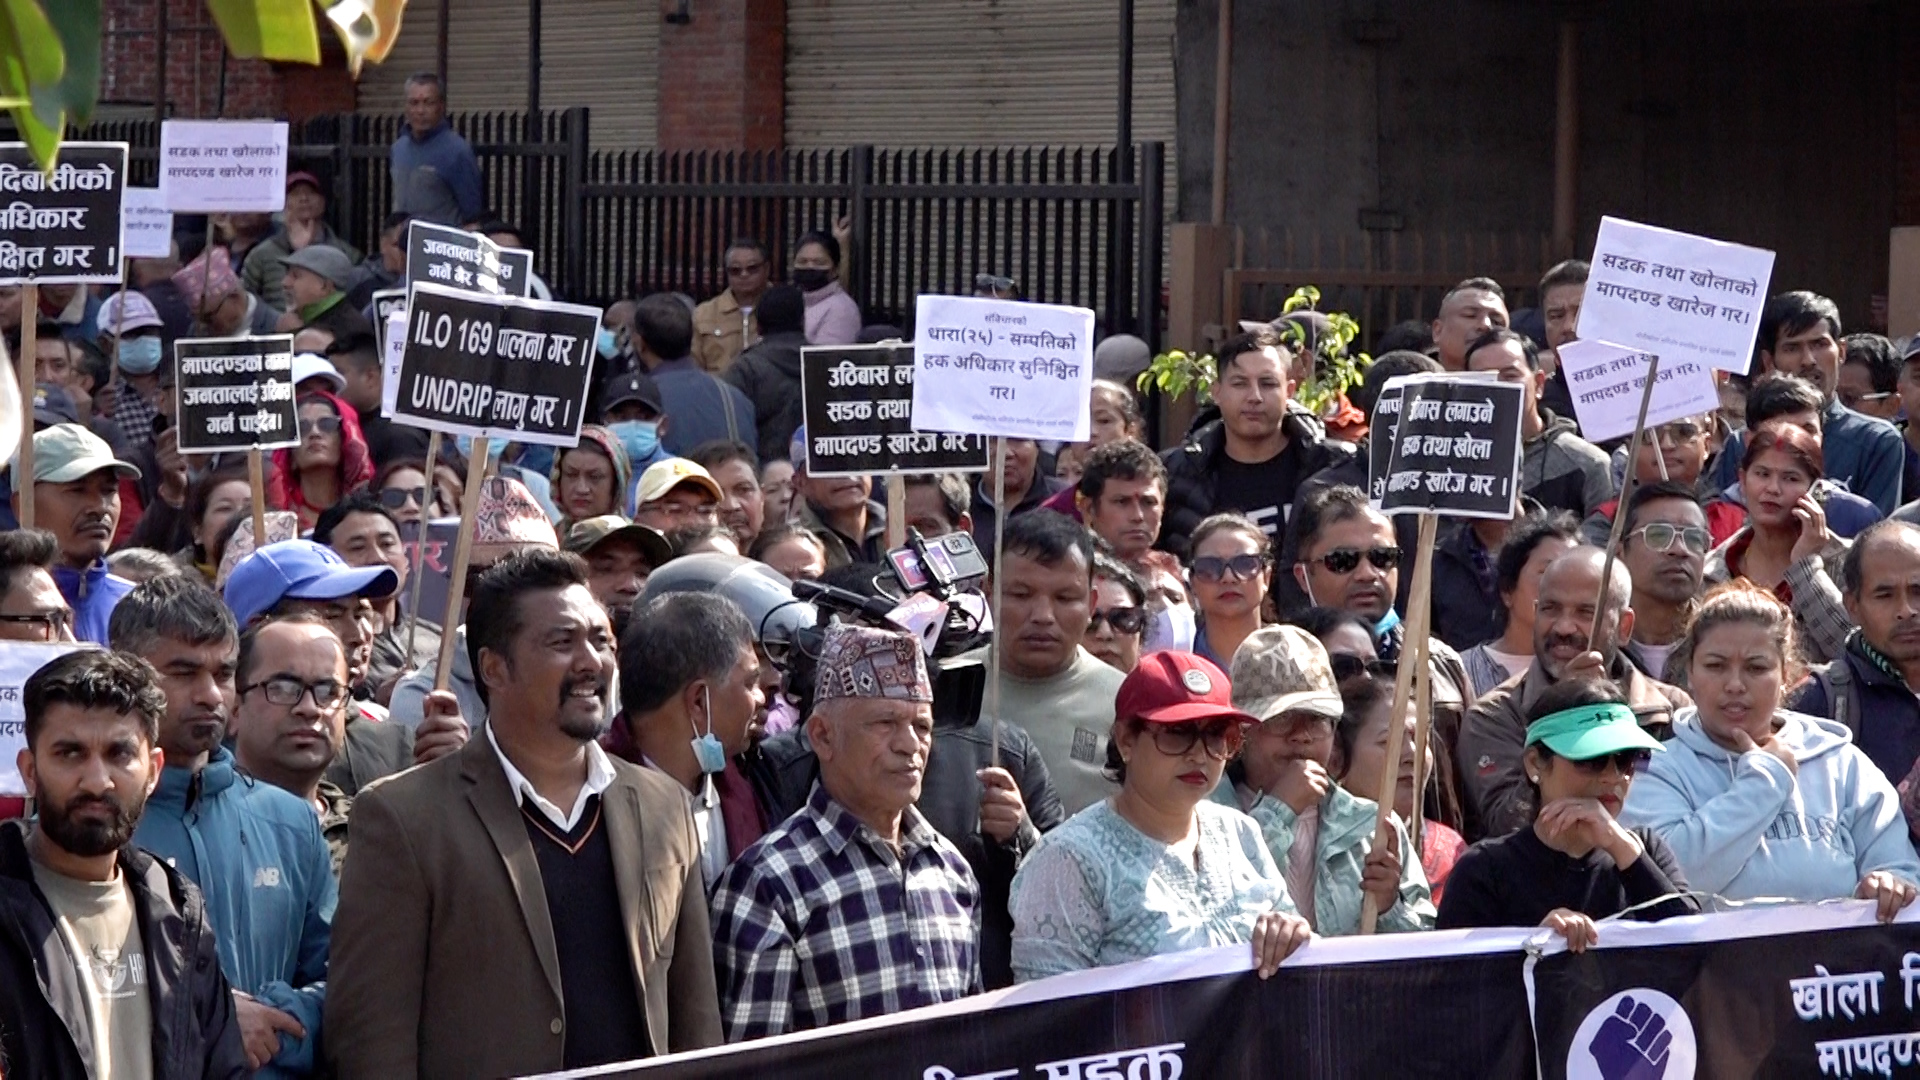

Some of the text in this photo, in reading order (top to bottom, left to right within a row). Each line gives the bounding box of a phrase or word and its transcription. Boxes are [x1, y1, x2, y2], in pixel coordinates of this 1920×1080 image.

[0, 163, 115, 192] दिबासीको
[0, 240, 46, 271] क्षित
[53, 245, 95, 268] गर
[1602, 252, 1758, 298] सडक तथा खोलाको
[1596, 280, 1663, 308] मापदण्ड
[1667, 295, 1717, 318] खारेज
[415, 309, 452, 349] ILO
[458, 318, 493, 356] 169
[497, 328, 547, 362] पालना
[547, 334, 577, 366] गर
[828, 360, 889, 387] उठिबास
[923, 352, 1080, 380] हक अधिकार सुनिश्चित
[1572, 363, 1608, 384] सडक
[1609, 354, 1636, 371] तथा
[411, 373, 493, 419] UNDRIP
[492, 391, 530, 431] लागु
[531, 394, 559, 427] गर
[1579, 381, 1630, 405] मापदण्ड
[826, 399, 911, 422] सडक तथा
[1444, 397, 1495, 424] लगाउने
[814, 434, 881, 457] मापदण्ड
[887, 430, 938, 455] खारेज
[1422, 435, 1452, 457] तथा
[1453, 431, 1493, 460] खोला
[1424, 467, 1468, 493] खारेज
[1470, 475, 1496, 496] गर
[1789, 963, 1885, 1021] खोला
[1814, 1031, 1920, 1080] मापदण्
